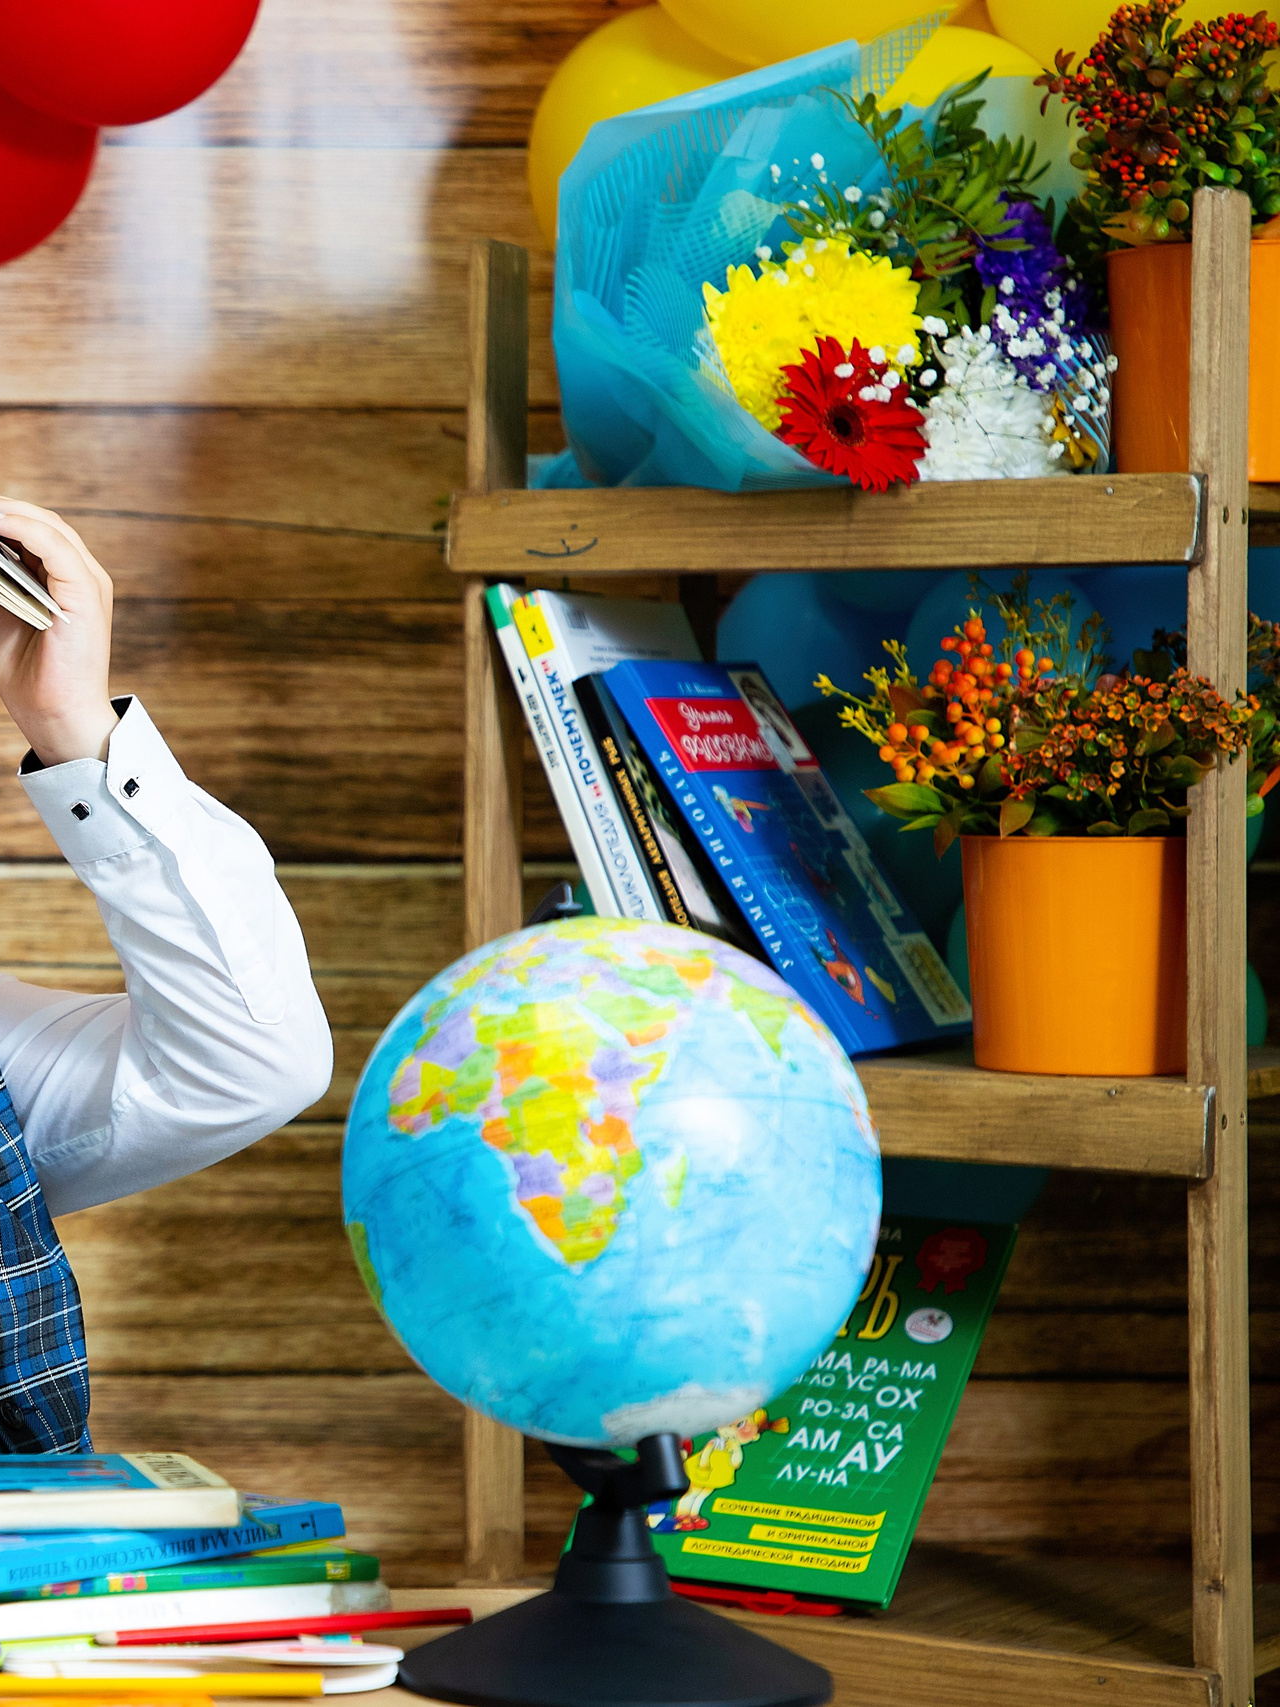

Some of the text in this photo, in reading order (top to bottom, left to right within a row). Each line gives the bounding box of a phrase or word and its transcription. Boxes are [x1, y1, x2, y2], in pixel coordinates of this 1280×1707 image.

[601, 735, 621, 766] РЫБ
[615, 767, 664, 865] АКВАРИУМНЫХ
[658, 750, 734, 867] РИСОВАТЬ
[593, 801, 646, 919] ЦИКЛОПЕДИЯ
[731, 875, 795, 970] УЧИМСЯ
[845, 1372, 877, 1391] УС
[863, 1356, 937, 1381] РА-МА
[800, 1397, 870, 1422] РО-ЗА
[875, 1385, 923, 1411] ОХ
[786, 1425, 842, 1452] АМ
[867, 1420, 904, 1442] СА
[837, 1440, 904, 1473] АУ
[776, 1462, 848, 1487] ЛУ-НА
[720, 1501, 876, 1528] СОЧЕТАНИЕ ТРАДИЦИОННОЙ
[202, 1530, 230, 1551] ДЛЯ
[767, 1530, 869, 1550] И ОРИГИНАЛЬНОЙ
[76, 1539, 196, 1573] ВНЕКЛАССНОГО
[690, 1541, 861, 1570] ЛОГОПЕДИЧЕСКОЙ МЕТОДИКИ
[8, 1561, 71, 1585] ЧТЕНИЯ
